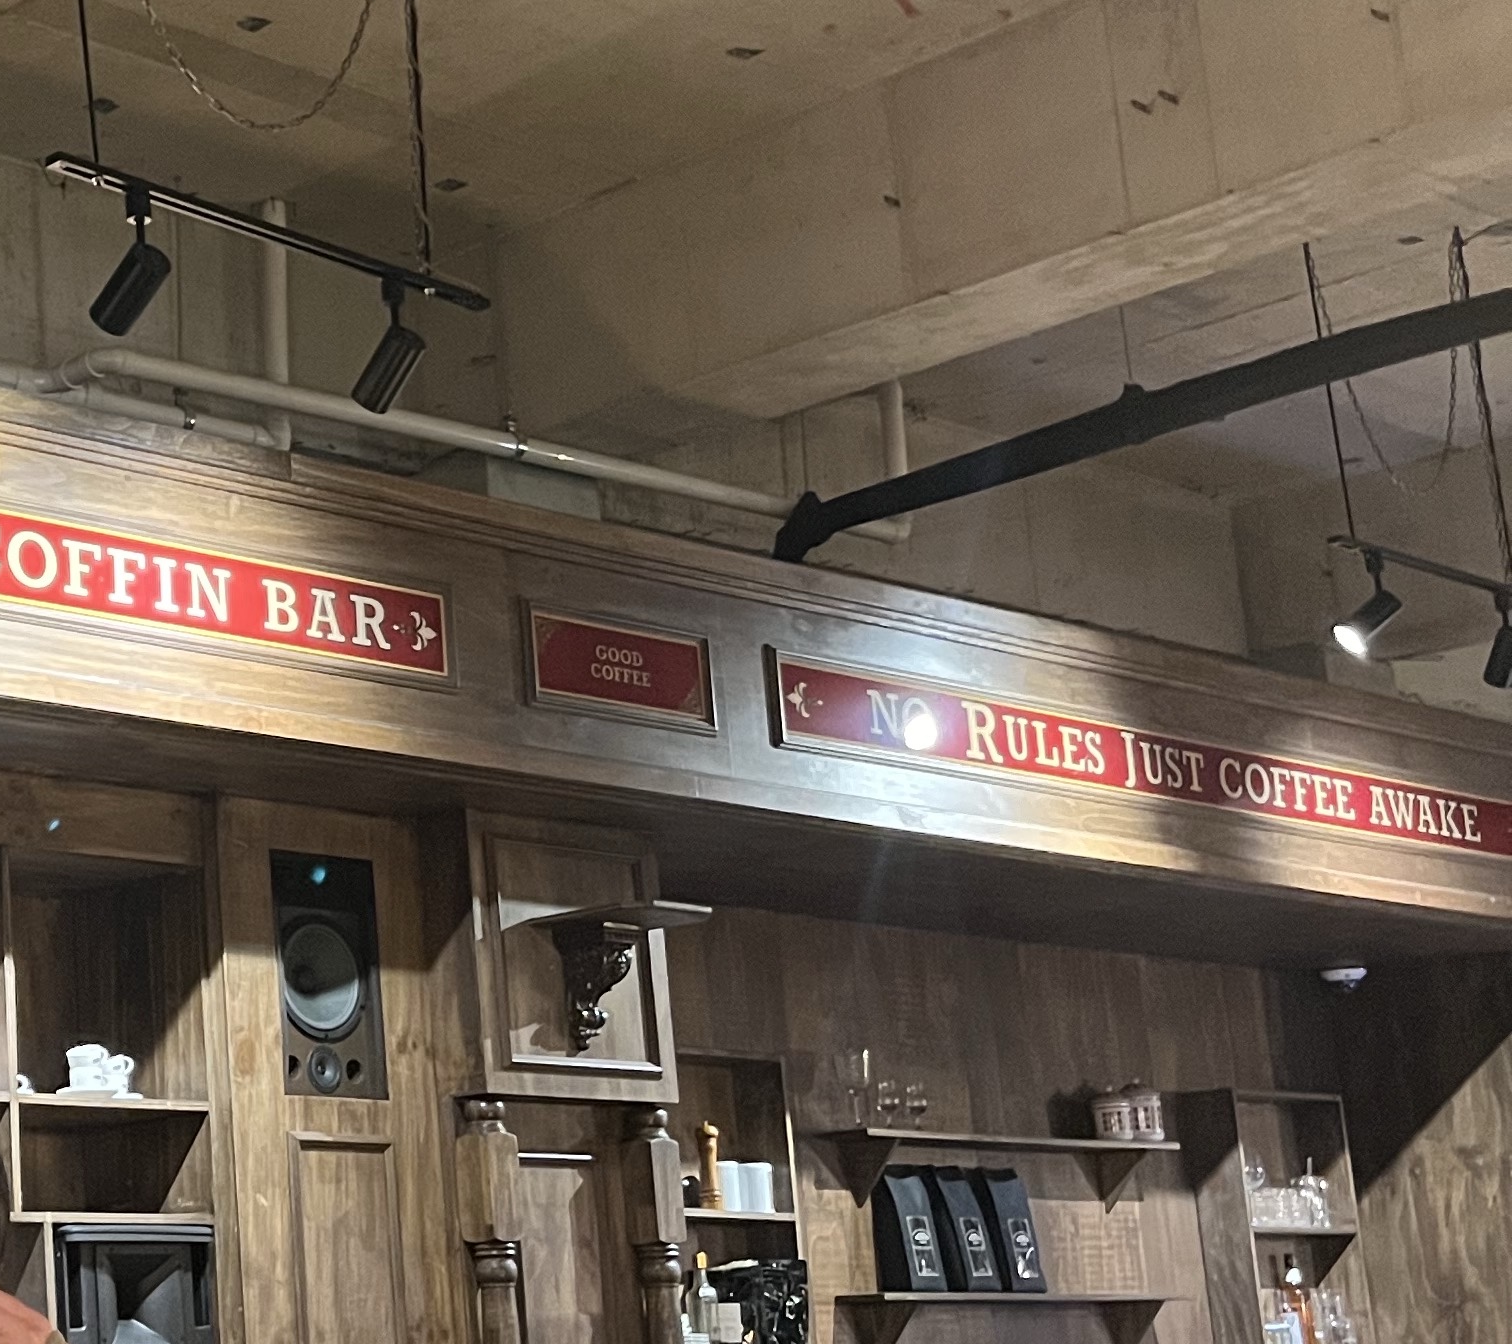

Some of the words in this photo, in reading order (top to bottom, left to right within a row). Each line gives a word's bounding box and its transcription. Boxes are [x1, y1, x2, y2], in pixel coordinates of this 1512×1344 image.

[260, 576, 392, 651] BAR
[590, 662, 652, 689] COFFEE
[594, 644, 644, 668] GOOD
[960, 699, 1106, 776] RULES
[1120, 730, 1204, 793] JUST
[1218, 757, 1356, 821] COFFEE
[1368, 784, 1482, 843] AWAKE
